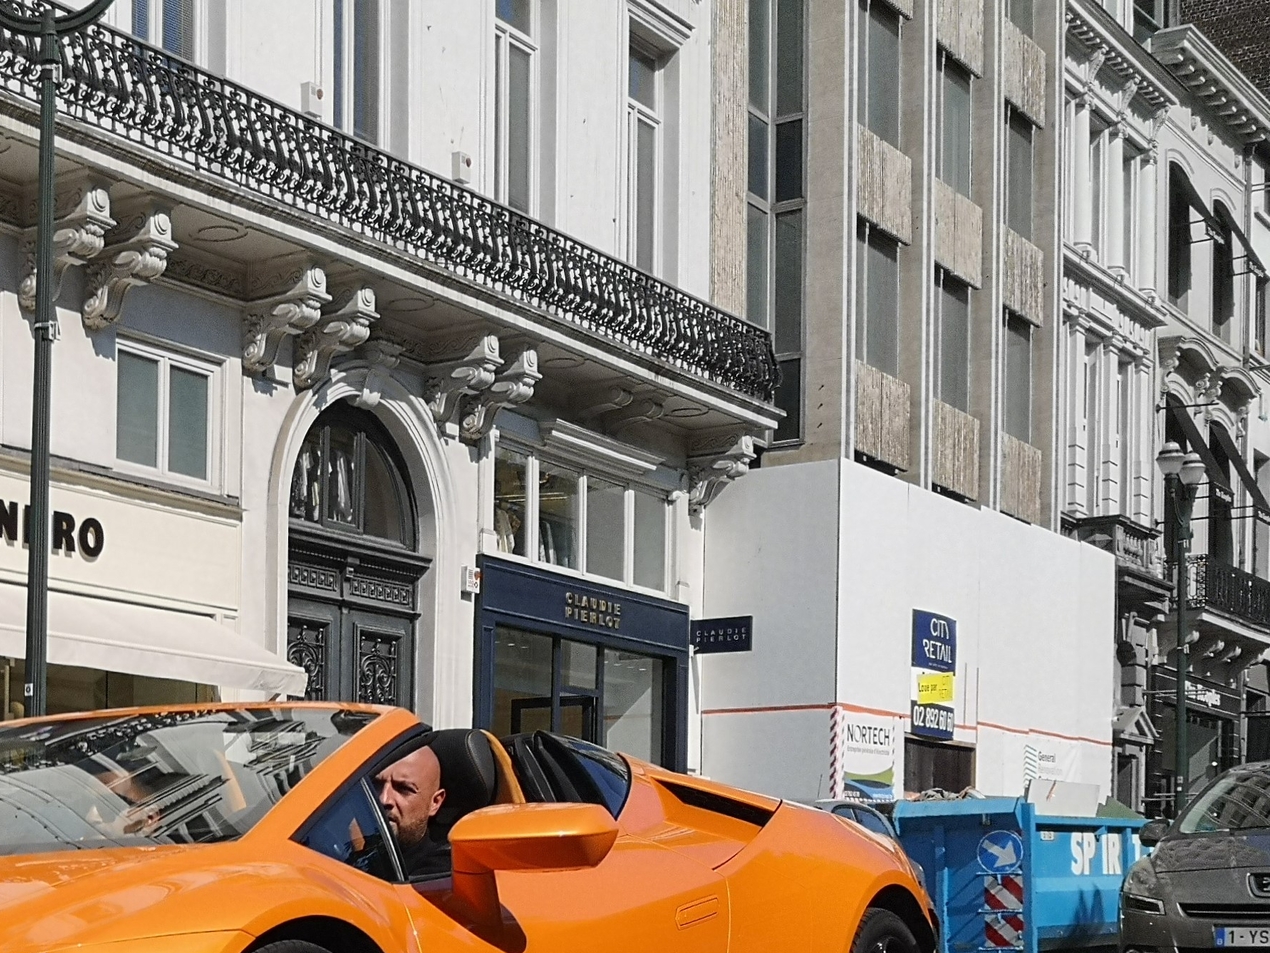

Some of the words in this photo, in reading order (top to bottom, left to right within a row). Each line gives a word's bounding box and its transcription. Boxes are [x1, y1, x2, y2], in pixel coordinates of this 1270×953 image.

[565, 592, 621, 615] CLAUDIE
[565, 606, 621, 629] PIERLOT
[696, 627, 746, 637] CLAUDIE
[696, 634, 746, 643] PIERLOT
[913, 706, 925, 726] 02
[926, 707, 939, 729] 892
[847, 724, 890, 746] NORTECH
